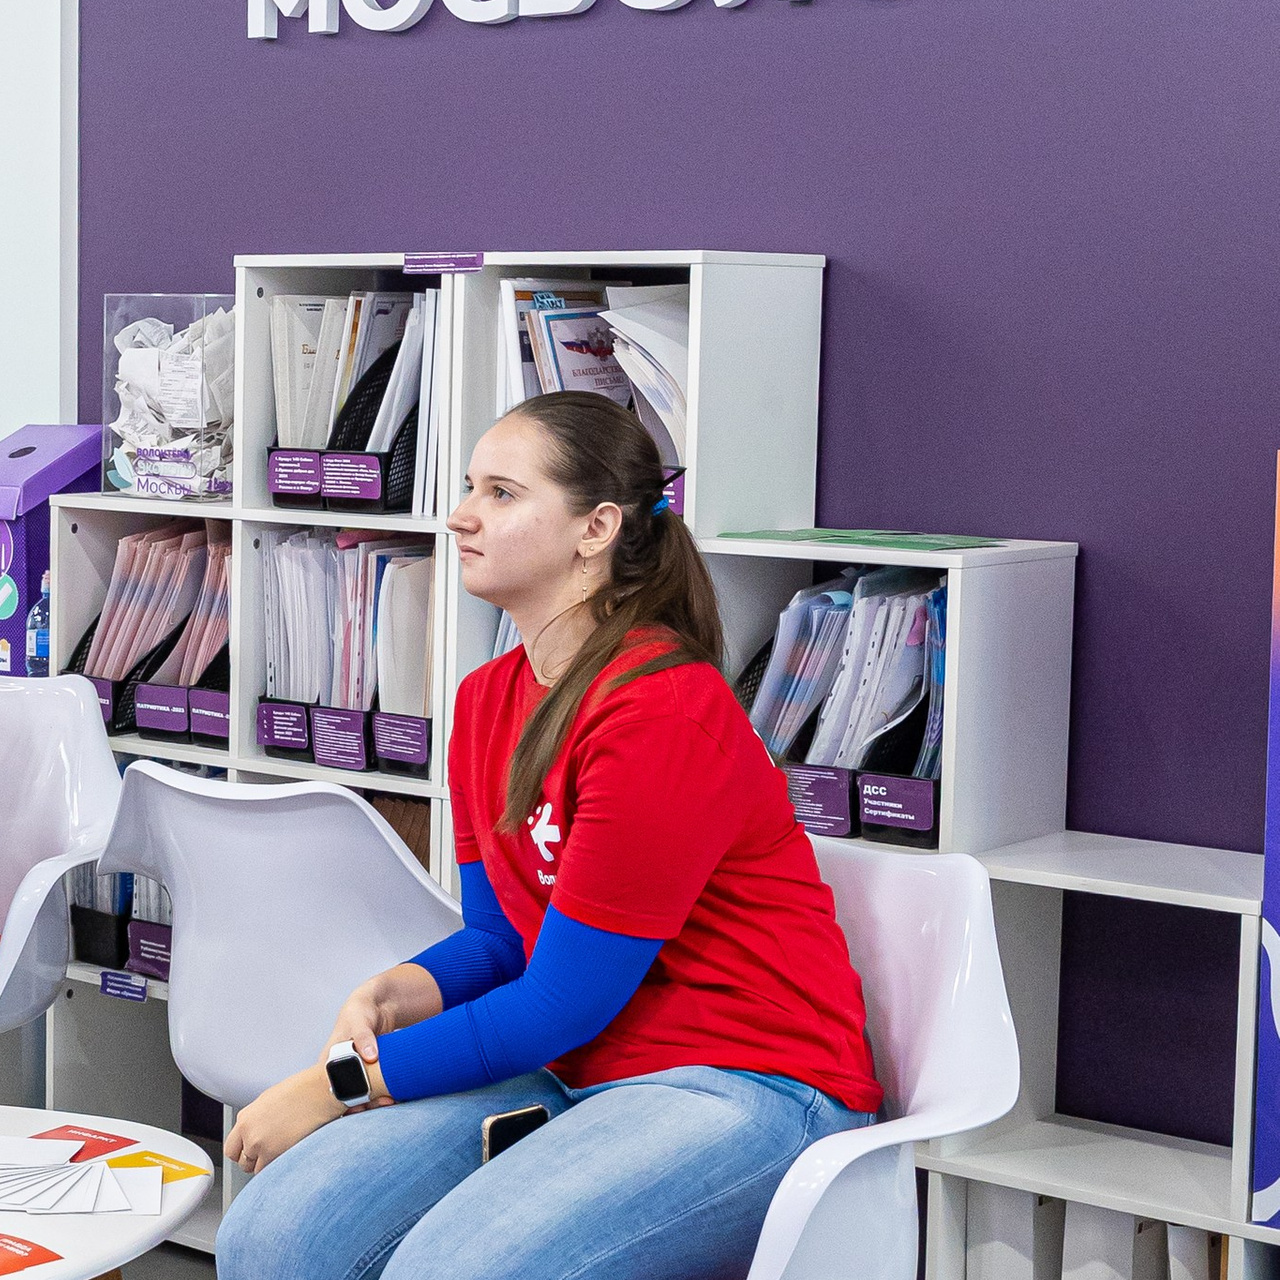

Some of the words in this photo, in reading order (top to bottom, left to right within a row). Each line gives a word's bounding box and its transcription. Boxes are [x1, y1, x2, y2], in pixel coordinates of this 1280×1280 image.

[863, 784, 888, 797] ДСС
[863, 797, 903, 810] Участники
[864, 807, 916, 821] Сертификаты
[536, 869, 556, 886] Вол
